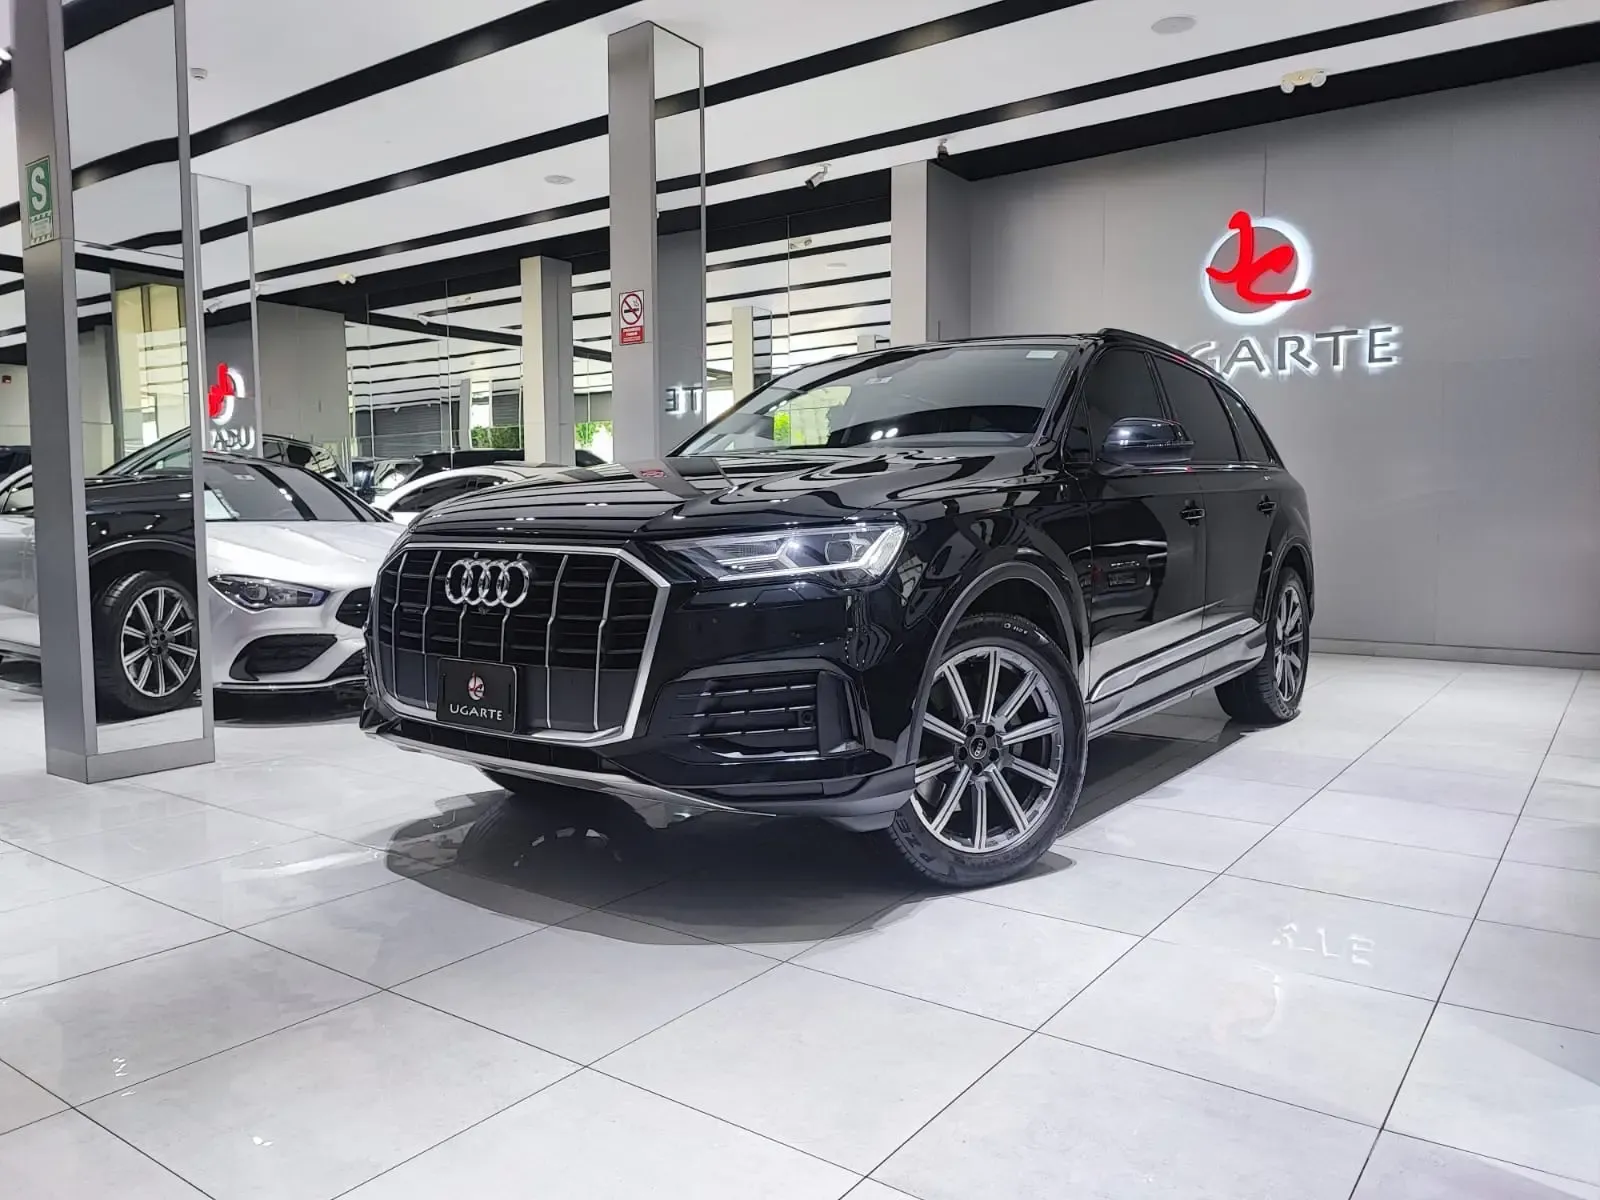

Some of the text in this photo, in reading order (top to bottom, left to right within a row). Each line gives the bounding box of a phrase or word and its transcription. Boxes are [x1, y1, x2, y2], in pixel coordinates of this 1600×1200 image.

[30, 166, 47, 211] S
[1186, 327, 1396, 375] GARTE
[449, 703, 503, 721] UGARTE
